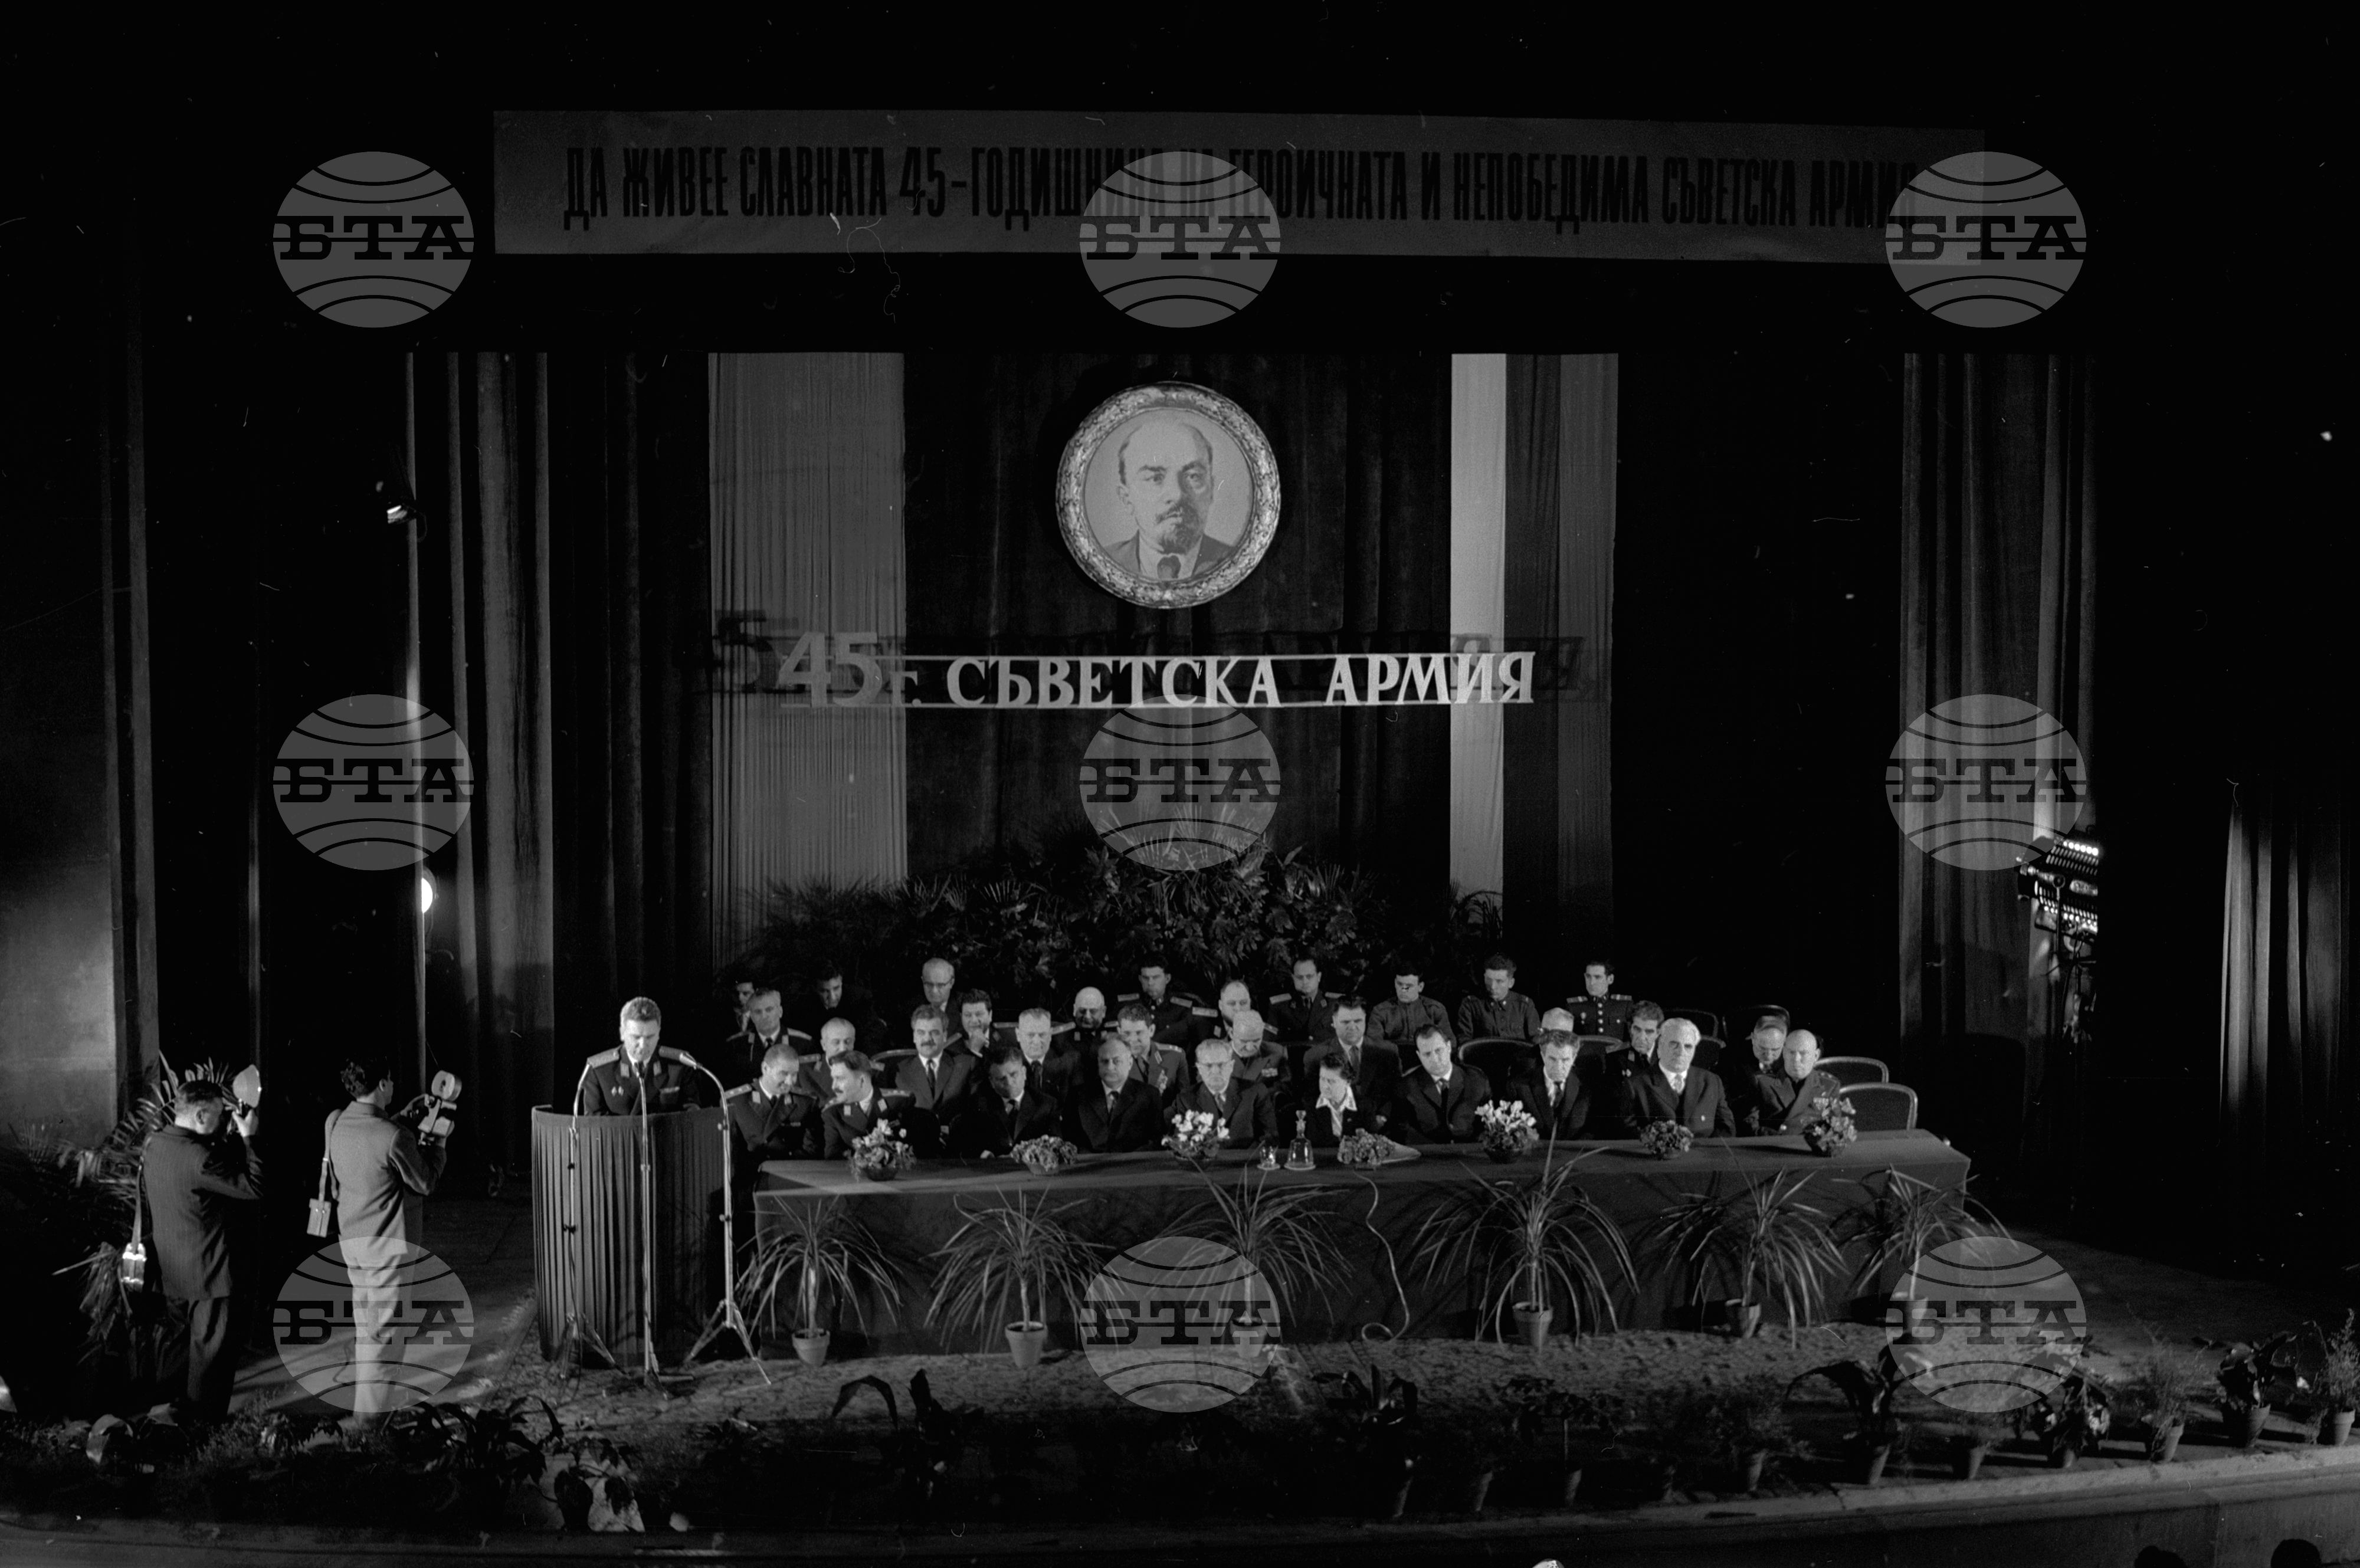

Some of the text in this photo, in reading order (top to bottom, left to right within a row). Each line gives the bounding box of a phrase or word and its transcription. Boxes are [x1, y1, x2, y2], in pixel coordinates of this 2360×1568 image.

[564, 147, 608, 231] ДА
[622, 147, 729, 216] ЖИВЕЕ
[739, 146, 887, 216] СЛАВНАТА
[1228, 148, 1408, 220] ГЕРОИЧНАТА
[1421, 152, 1440, 221] И
[1453, 152, 1650, 235] НЕПОБЕДИМА
[1661, 156, 1796, 227] СЪВЕТСКА
[1810, 159, 1917, 230] АРМИЯ
[946, 655, 1282, 708] СЪВЕТСКА
[1324, 651, 1535, 706] АРМИЯ
